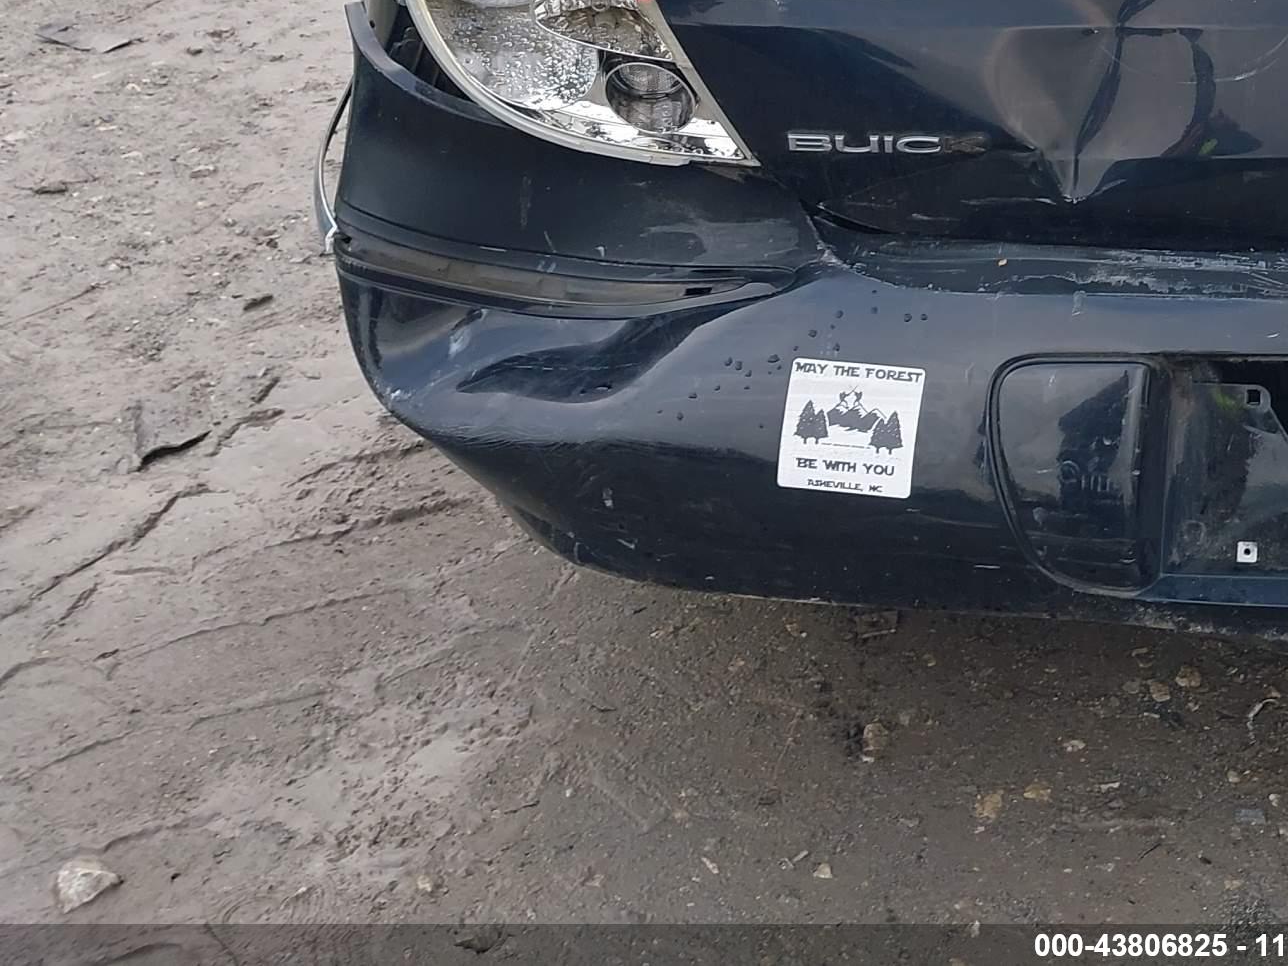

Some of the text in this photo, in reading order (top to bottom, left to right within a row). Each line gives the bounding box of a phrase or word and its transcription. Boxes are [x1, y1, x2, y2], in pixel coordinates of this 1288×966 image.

[795, 362, 923, 383] MAY THE FOREST
[796, 457, 895, 476] BE WITH YOU
[868, 485, 883, 493] NC
